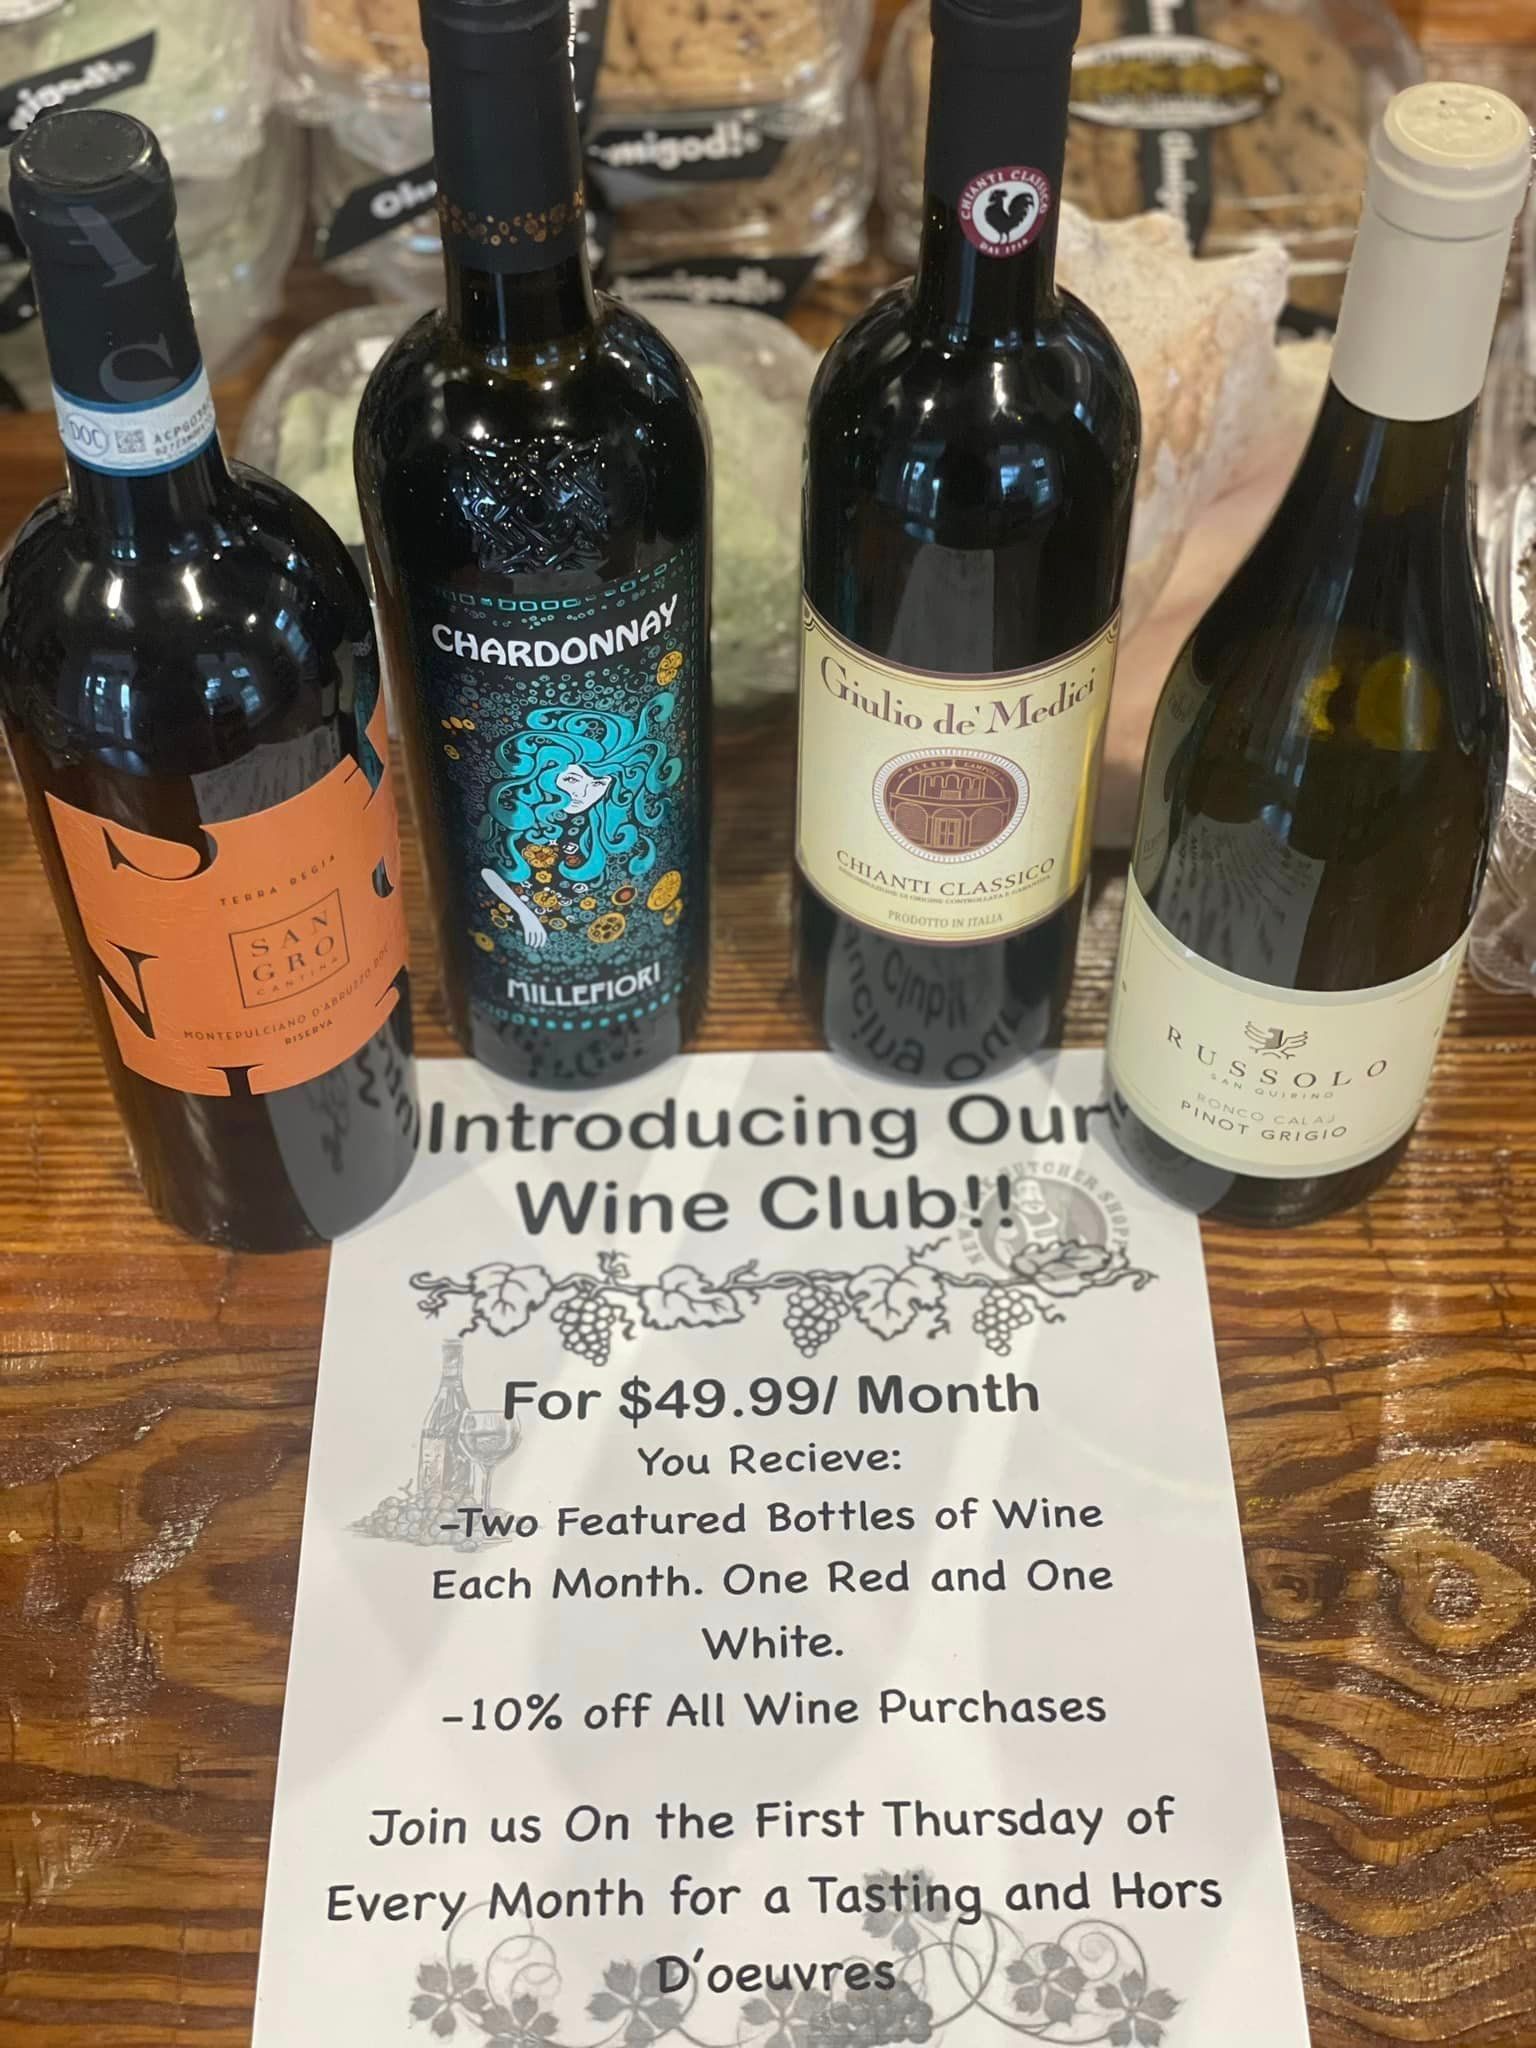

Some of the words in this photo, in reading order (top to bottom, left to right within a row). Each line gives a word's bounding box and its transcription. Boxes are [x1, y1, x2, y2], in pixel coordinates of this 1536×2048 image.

[961, 172, 1004, 220] CHIANTI
[69, 420, 104, 450] DOC
[432, 594, 678, 667] CHARDONNAY
[820, 655, 922, 731] Giulio
[933, 702, 981, 736] de'
[984, 667, 1096, 735] Medici
[219, 886, 278, 906] TERRA
[289, 854, 336, 886] REGIA
[836, 849, 930, 895] CHIANTI
[939, 857, 1056, 897] CLASSICO
[250, 909, 329, 957] SAN
[888, 909, 950, 929] PRODOTTO
[952, 917, 964, 929] IN
[968, 912, 1004, 929] ITALIA
[252, 935, 335, 982] GRO
[256, 957, 339, 996] CANTINA
[183, 1012, 306, 1041] MONTEPULCIANO
[311, 969, 372, 1018] D'ABRUZZO
[507, 961, 662, 1007] MILLEFIORI
[284, 1018, 334, 1045] RISERVA
[1167, 1024, 1388, 1089] RUSSOLO
[1196, 1091, 1265, 1123] RONCO
[1210, 1072, 1243, 1090] SAN
[1254, 1087, 1335, 1099] QUIRINO
[428, 1094, 918, 1159] Introducing
[947, 1093, 1108, 1145] Our
[1181, 1099, 1250, 1135] PINOT
[1260, 1125, 1347, 1142] GRIGIO
[515, 1180, 730, 1236] Wine
[759, 1174, 1014, 1231] Club!!
[504, 1380, 602, 1421] For
[618, 1374, 839, 1429] $49.99/
[858, 1372, 1040, 1415] Month
[637, 1447, 710, 1477] You
[729, 1442, 902, 1475] Recieve:
[440, 1507, 539, 1538] -Two
[557, 1502, 746, 1537] Featured
[767, 1499, 916, 1533] Bottles
[934, 1497, 980, 1530] of
[992, 1497, 1104, 1530] Wine
[432, 1567, 532, 1600] Each
[552, 1565, 704, 1599] Month.
[723, 1563, 808, 1596] One
[828, 1559, 909, 1593] Red
[930, 1558, 1007, 1593] and
[1026, 1558, 1114, 1592] One
[701, 1624, 844, 1661] White.
[441, 1692, 563, 1731] -10%
[583, 1692, 653, 1729] off
[665, 1692, 725, 1728] All
[743, 1690, 860, 1727] Wine
[878, 1688, 1107, 1725] Purchases
[368, 1807, 467, 1846] Join
[490, 1813, 542, 1843] us
[565, 1804, 630, 1842] On
[655, 1802, 735, 1839] the
[756, 1799, 865, 1838] First
[881, 1798, 1104, 1846] Thursday
[1126, 1795, 1176, 1835] of
[327, 1884, 467, 1931] Every
[488, 1877, 644, 1919] Month
[669, 1874, 741, 1916] for
[763, 1885, 791, 1914] a
[807, 1874, 983, 1926] Tasting
[1005, 1871, 1091, 1911] and
[1112, 1871, 1223, 1910] Hors
[655, 1947, 897, 1994] D'oeuvres
